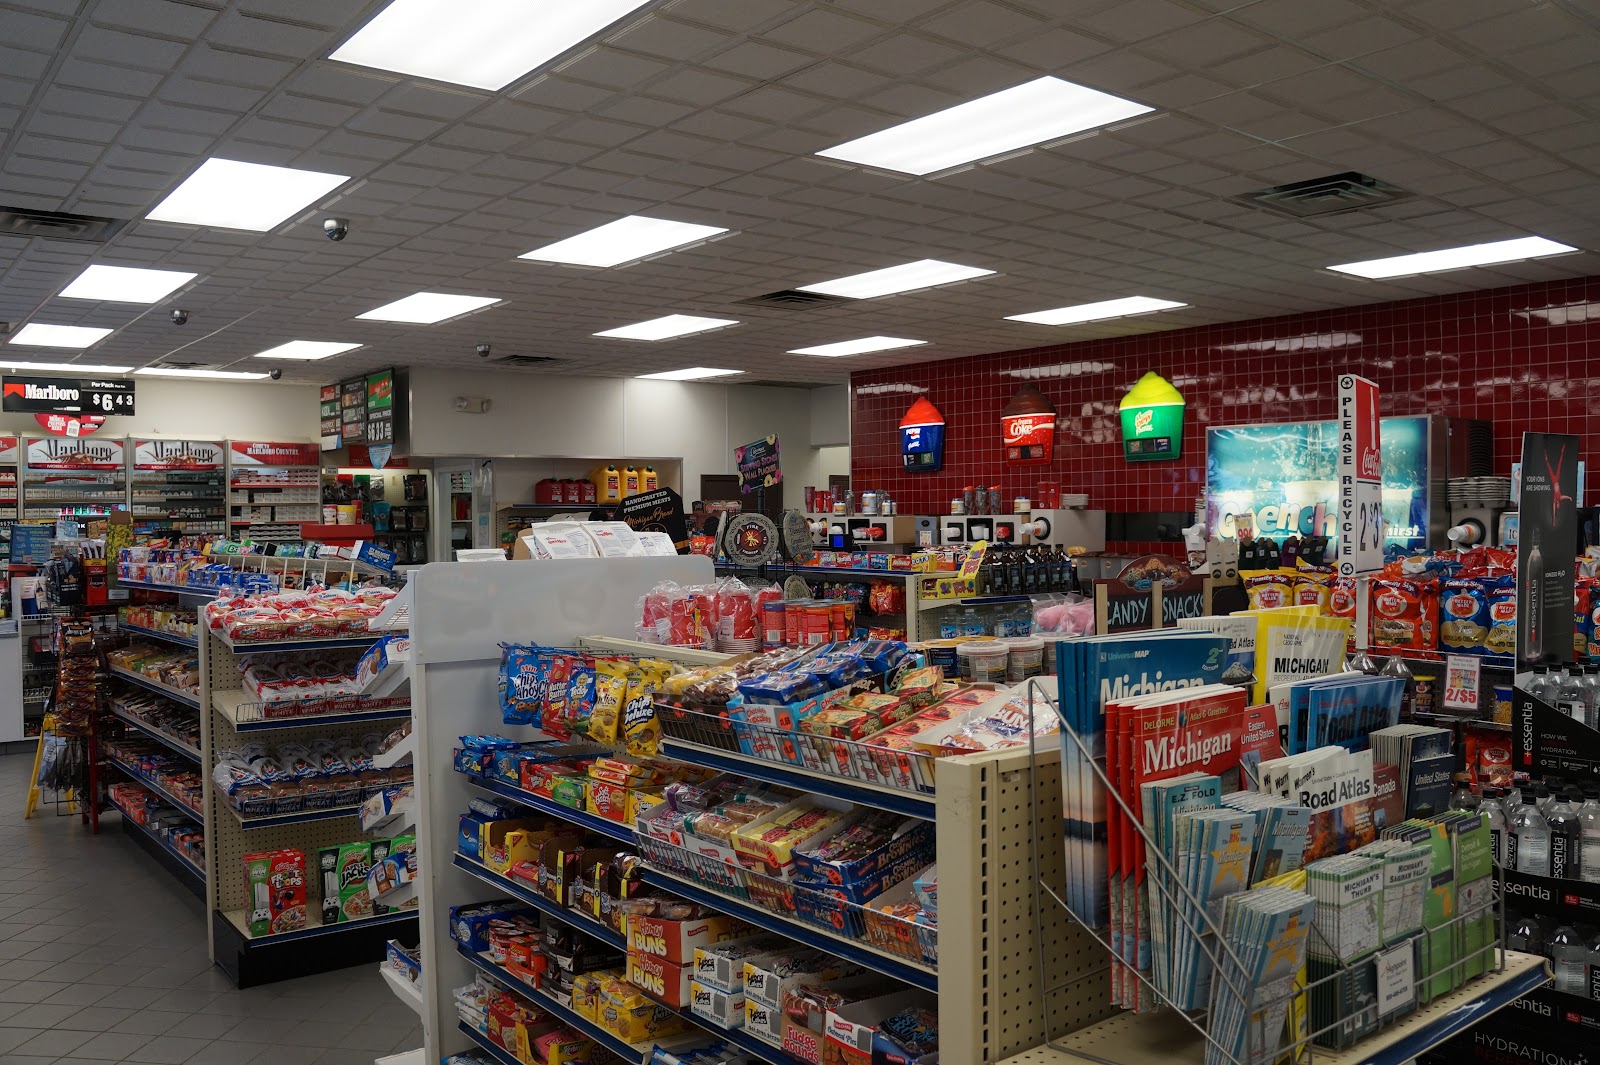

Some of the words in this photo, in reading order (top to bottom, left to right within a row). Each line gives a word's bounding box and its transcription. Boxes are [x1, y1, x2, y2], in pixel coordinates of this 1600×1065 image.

[25, 384, 79, 400] Marlboro
[1010, 422, 1033, 436] Coke
[1342, 397, 1352, 465] PLEASE
[46, 440, 112, 462] Marlboro
[153, 441, 213, 464] Marlboro
[623, 501, 651, 513] PREMIUM
[624, 490, 668, 507] HANDCRAFTED
[1217, 500, 1337, 542] Qench
[1342, 475, 1352, 555] RECYCLE
[1386, 524, 1420, 537] hirst
[912, 554, 929, 565] DOTS
[1107, 597, 1149, 626] ANDY
[1238, 636, 1255, 649] Atlas
[521, 664, 538, 673] Mini
[1274, 657, 1329, 674] MICHIGAN
[517, 671, 539, 688] Chips
[598, 693, 618, 705] dies
[819, 688, 848, 709] Chocolate
[1100, 670, 1205, 715] Michigan
[1445, 687, 1477, 704] 2/$5
[271, 708, 294, 717] WHITE
[302, 705, 325, 714] WHITE
[627, 697, 651, 715] Chips
[1189, 712, 1202, 722] Atlas
[1317, 709, 1357, 747] Road
[1357, 702, 1397, 731] Atlas
[1248, 721, 1266, 731] Eastern
[1522, 702, 1533, 752] essentia
[1240, 732, 1258, 745] United
[1258, 729, 1275, 740] States
[1540, 733, 1555, 741] HOW
[1144, 729, 1232, 776] Michigan
[1540, 746, 1577, 756] HYDRATION
[1294, 766, 1316, 790] Warren's
[1414, 771, 1432, 786] United
[1431, 770, 1451, 782] States
[598, 784, 610, 797] Soft
[1192, 788, 1216, 801] FOLD
[1300, 787, 1337, 809] Road
[1338, 778, 1371, 798] Atlas
[1373, 779, 1397, 798] Canada
[305, 799, 331, 807] WHEAT
[595, 792, 611, 804] Batch
[245, 805, 271, 814] WHEAT
[277, 803, 300, 812] WHEAT
[1228, 832, 1240, 844] BIG
[1272, 822, 1308, 840] Michigan
[1217, 849, 1249, 865] Michigan
[1398, 859, 1424, 872] MICHIGAN'S
[1554, 837, 1564, 879] essentia
[340, 865, 370, 890] JACKS
[1344, 872, 1380, 893] MICHIGAN'S
[1389, 872, 1410, 884] SAGINAW
[1409, 867, 1428, 878] VALLEY
[1351, 885, 1372, 900] THUMB
[639, 918, 664, 937] Honey
[634, 933, 667, 957] BUNS
[639, 953, 664, 973] Honey
[696, 955, 714, 967] Zebra
[633, 969, 666, 995] BUNS
[745, 972, 764, 983] Zebra
[693, 989, 711, 1001] Zebra
[748, 1007, 767, 1019] Zebra
[1509, 997, 1552, 1017] entia
[787, 1026, 817, 1048] Fudge
[827, 1026, 845, 1040] Oatmeal
[845, 1034, 857, 1047] Pies
[784, 1039, 820, 1064] Rounds
[1475, 1031, 1571, 1065] HYDRATION
